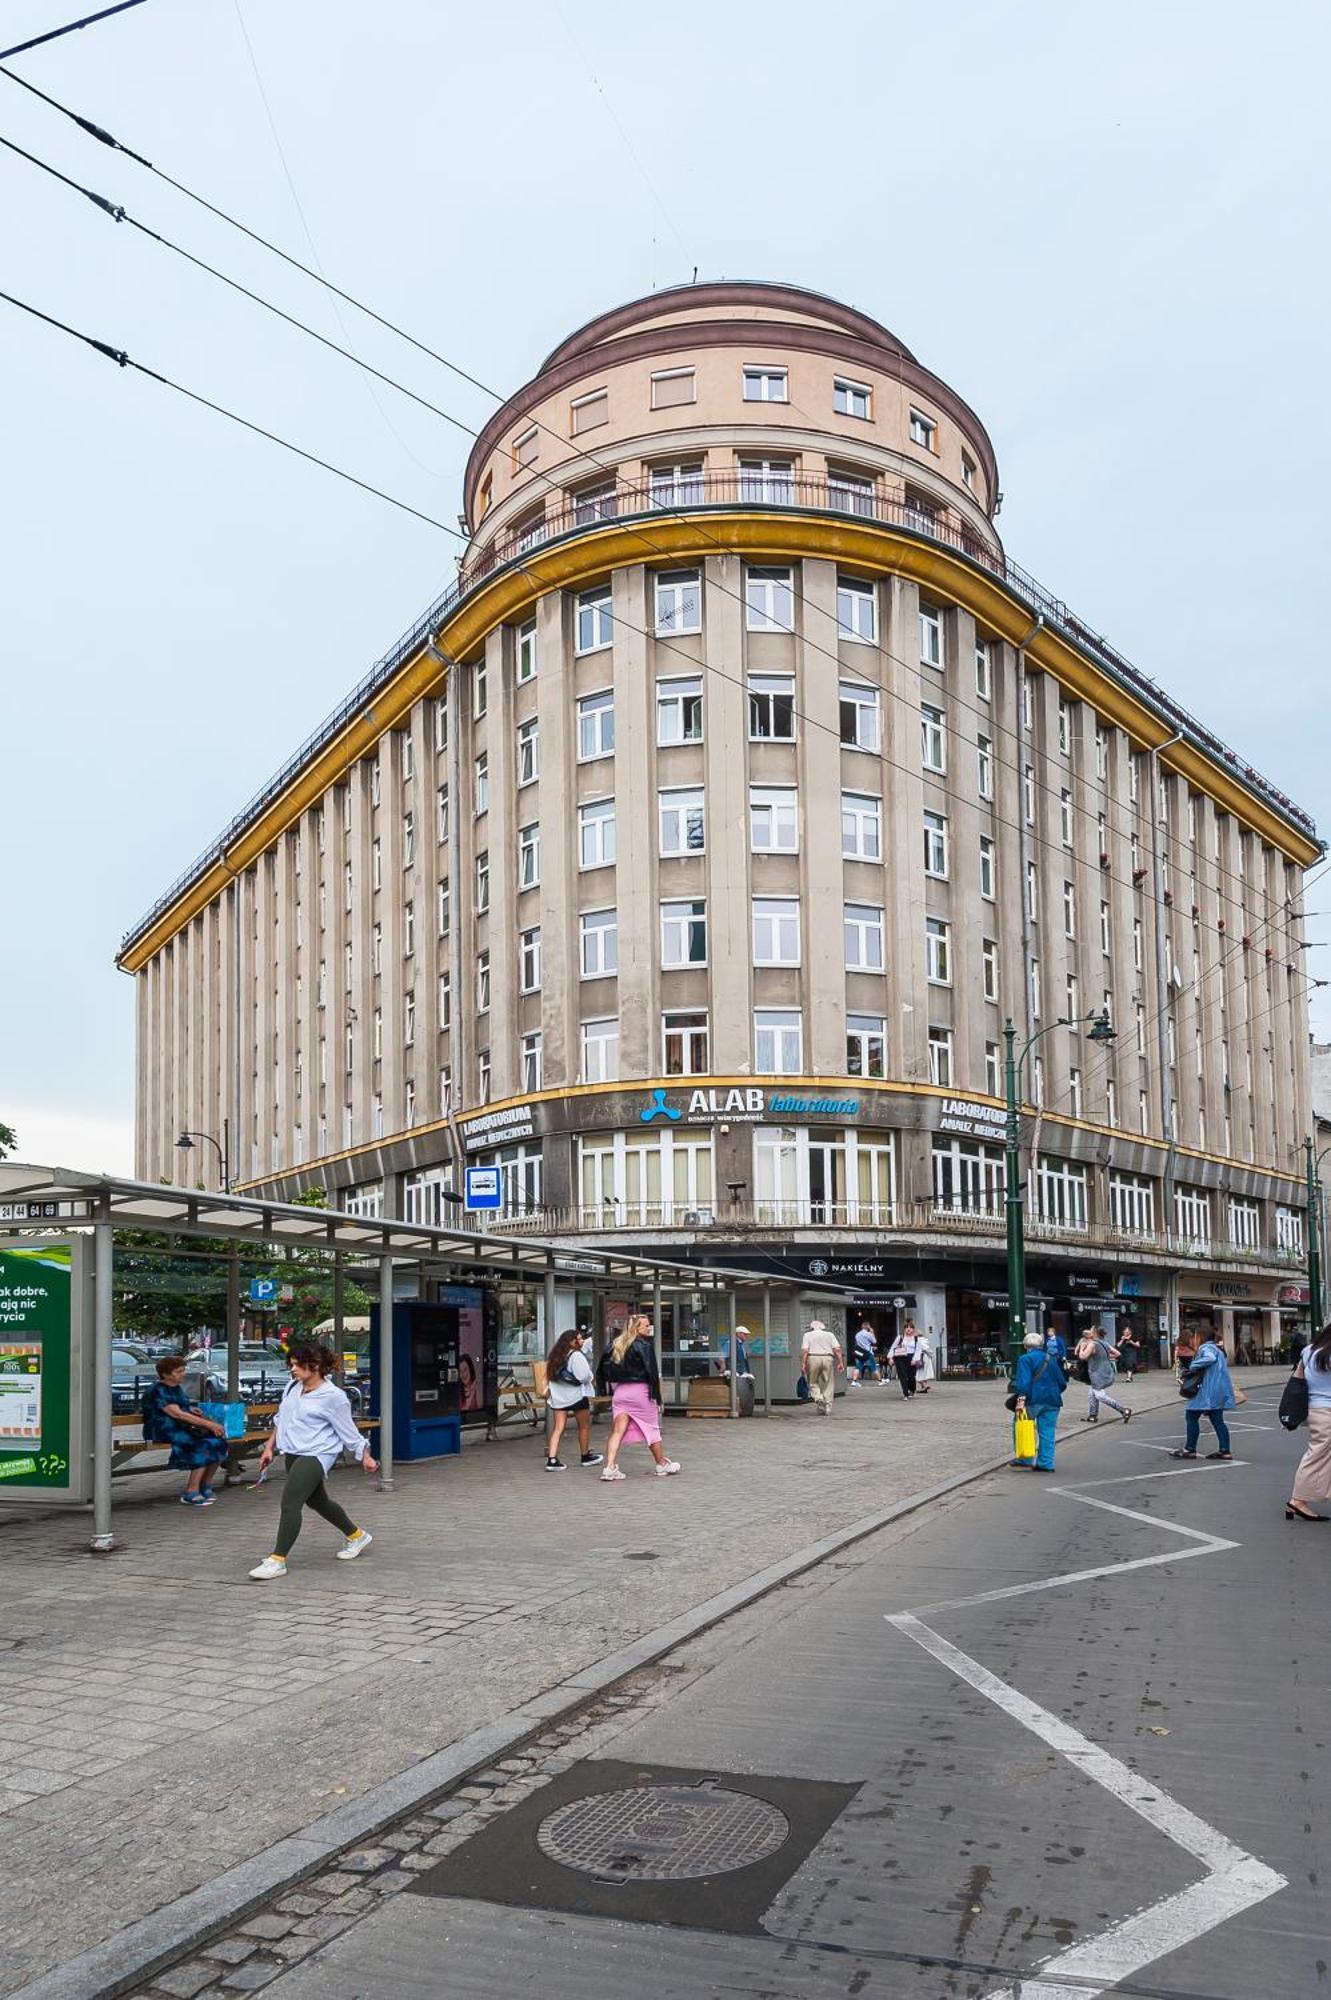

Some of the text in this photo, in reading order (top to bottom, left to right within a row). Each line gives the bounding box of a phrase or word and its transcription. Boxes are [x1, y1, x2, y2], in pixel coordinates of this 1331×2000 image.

[688, 1089, 860, 1114] ALAB laboratoria
[463, 1105, 532, 1136] LABORATORIUM
[2, 1207, 10, 1217] 24
[16, 1206, 25, 1216] 44
[30, 1205, 39, 1216] 64
[831, 1264, 884, 1272] NAKIELNY
[13, 1286, 48, 1297] dobre,
[20, 1298, 37, 1309] nic
